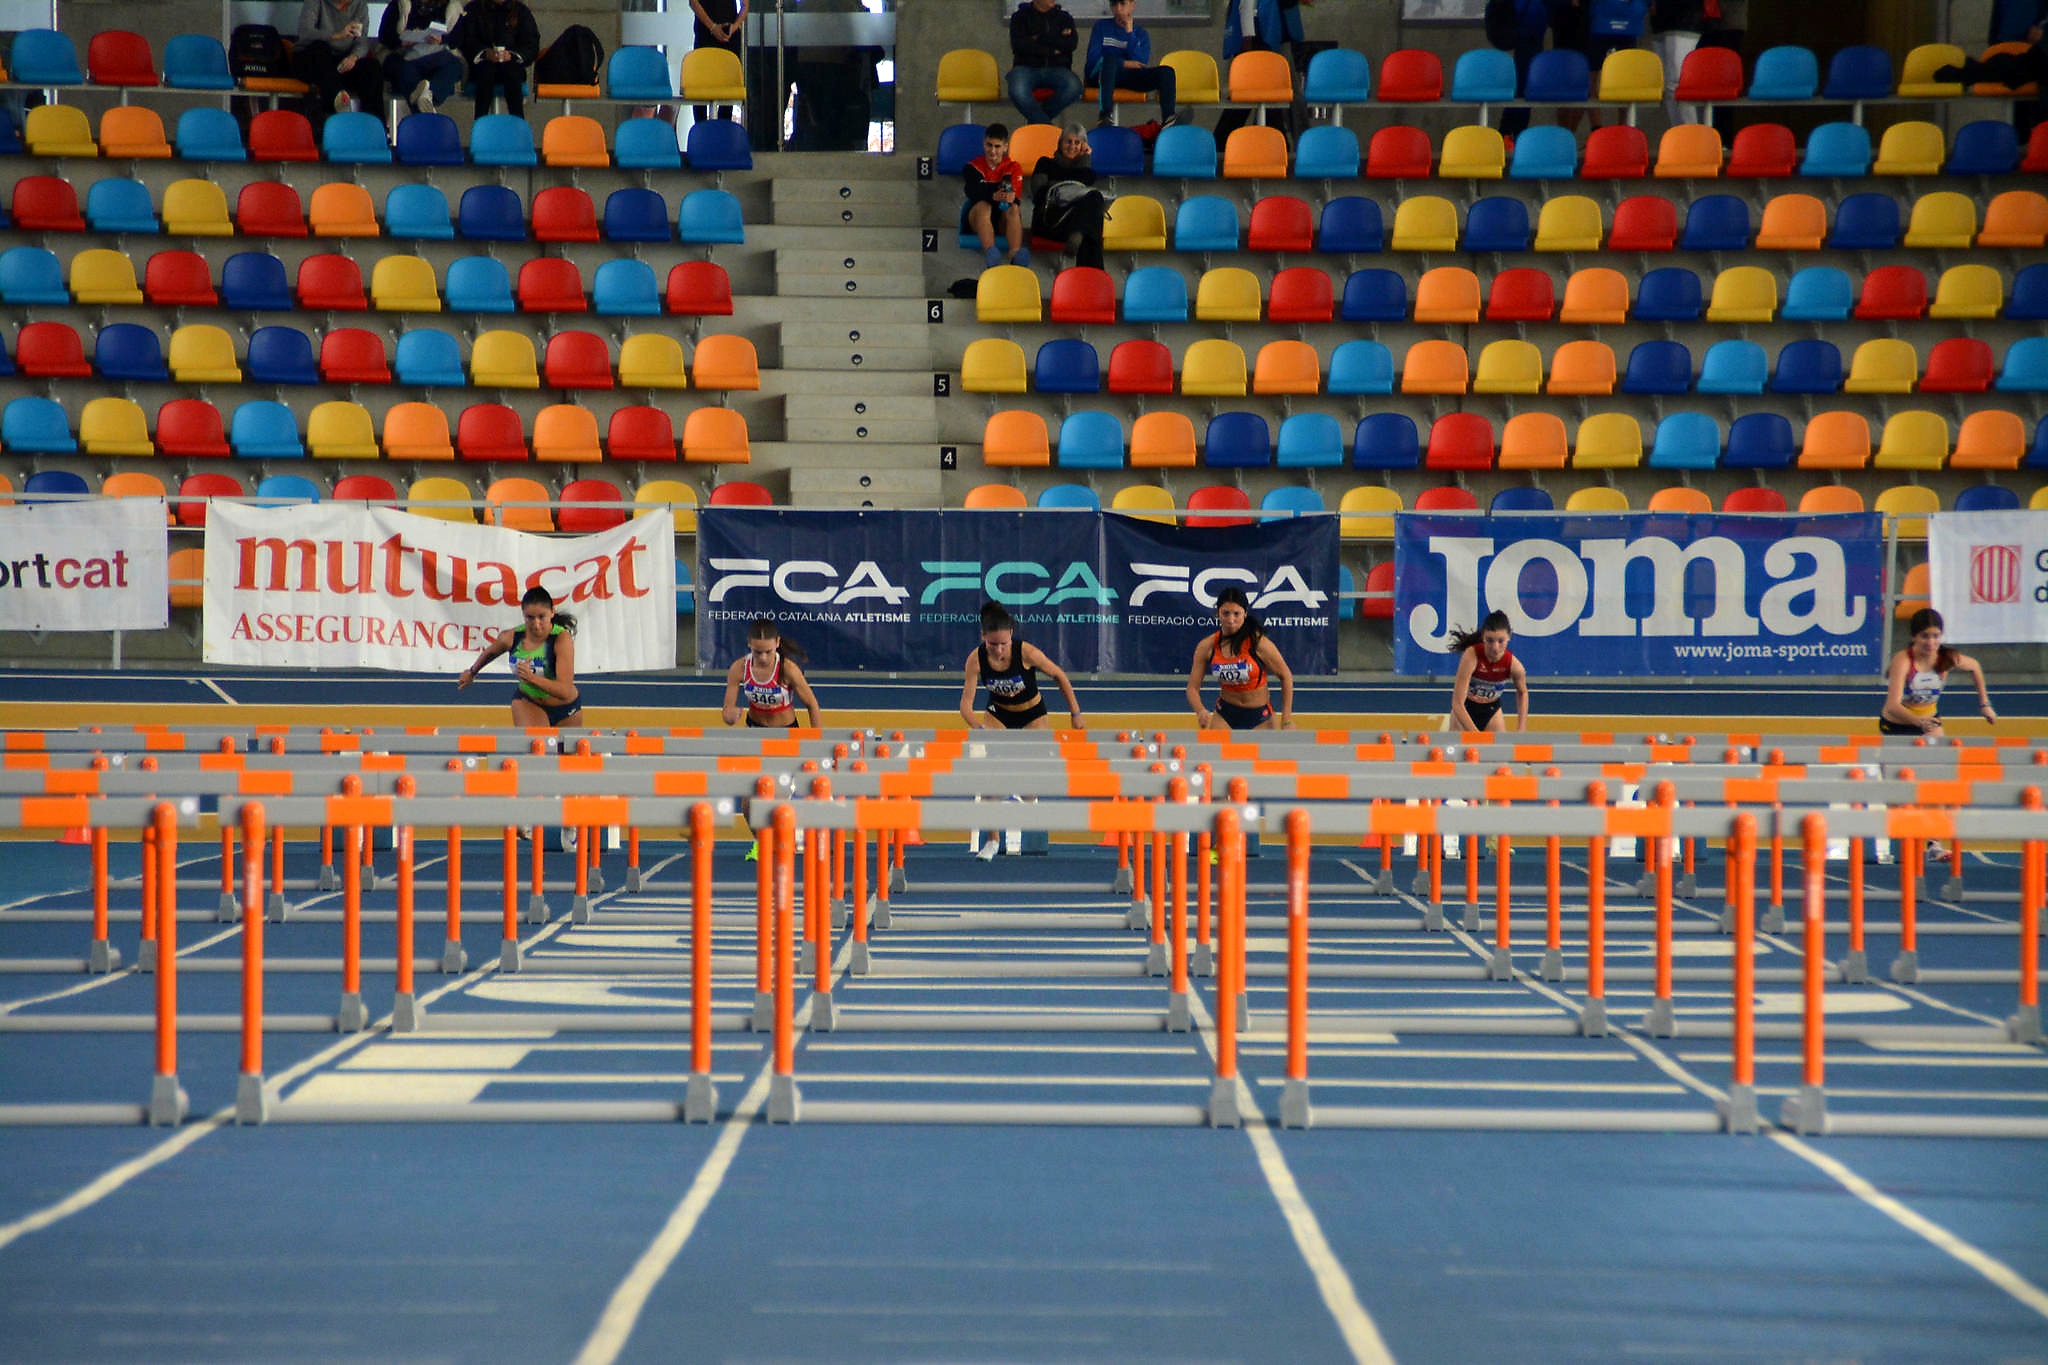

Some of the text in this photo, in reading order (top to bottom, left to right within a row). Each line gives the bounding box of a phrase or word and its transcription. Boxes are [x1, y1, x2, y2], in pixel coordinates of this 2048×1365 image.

[921, 163, 929, 175] 8
[926, 235, 934, 247] 7
[931, 306, 940, 319] 6
[938, 379, 946, 391] 5
[943, 452, 953, 464] 4
[233, 532, 650, 607] mutuacat
[709, 558, 910, 604] FCA
[920, 562, 1119, 605] FCA
[1129, 563, 1329, 609] FCA
[708, 609, 911, 623] FEDERACIÓ CATALANA ATLETISME
[1057, 613, 1120, 624] ATLETISME
[1128, 614, 1194, 626] FEDERACIÓ
[1264, 617, 1329, 627] ATLETISME
[231, 612, 500, 652] ASSEGURANCES
[1674, 642, 1868, 662] www.joma-sport.com
[752, 693, 777, 704] 346
